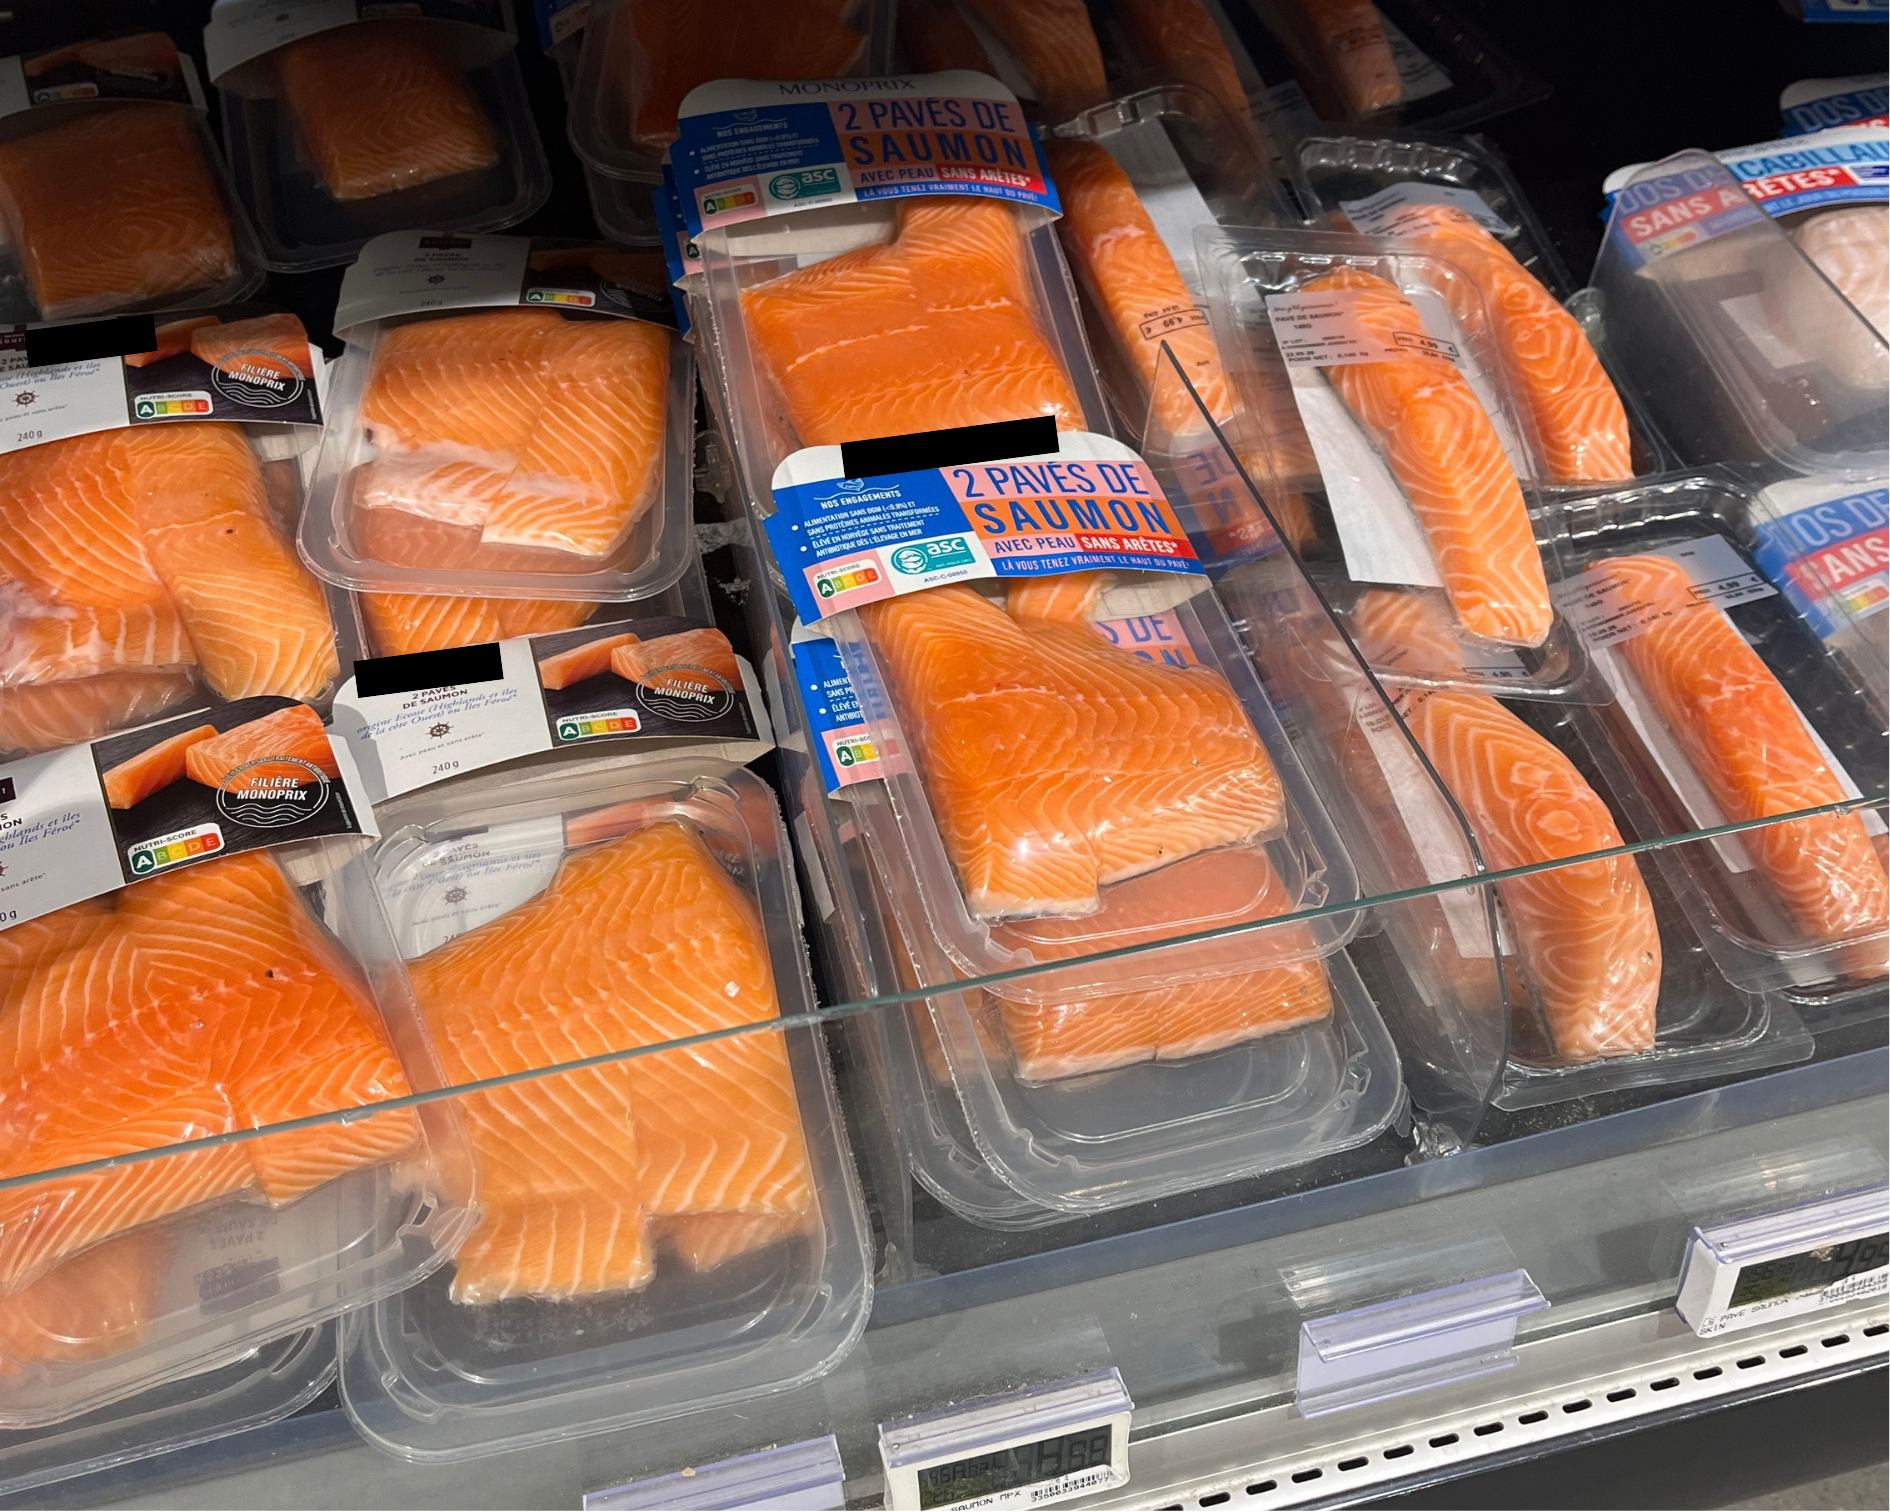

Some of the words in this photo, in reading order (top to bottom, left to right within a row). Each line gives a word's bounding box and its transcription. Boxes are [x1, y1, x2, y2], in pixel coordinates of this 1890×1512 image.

[778, 78, 917, 97] MONOPRIX
[838, 103, 862, 131] 2
[868, 97, 967, 129] PAVÉS
[972, 101, 1016, 133] DE
[850, 133, 1028, 170] SAUMON
[801, 169, 836, 184] asc
[860, 168, 895, 184] AVEC
[900, 167, 935, 182] PEAU
[940, 166, 977, 180] SANS
[877, 186, 900, 196] VOUS
[901, 184, 926, 193] TENEZ
[929, 183, 970, 192] VRAIMENT
[971, 184, 981, 193] LE
[1630, 195, 1714, 237] SANS
[2, 357, 10, 365] 2
[240, 362, 280, 380] FILIÈRE
[228, 370, 286, 392] MONOPRIX
[17, 429, 35, 443] 240
[36, 429, 43, 439] g
[953, 468, 985, 498] 2
[984, 461, 1097, 496] PAVÉS
[1097, 463, 1149, 495] DE
[820, 499, 840, 510] NOS
[840, 490, 902, 506] ENGAGEMENTS
[804, 512, 849, 528] ALIMENTATION
[849, 507, 867, 518] SANS
[807, 526, 825, 537] SANS
[860, 513, 892, 525] ANIMALES
[892, 505, 940, 519] TRANSFORMÉES
[974, 498, 1172, 535] SAUMON
[870, 524, 888, 535] SANS
[887, 519, 925, 531] TRAITEMENT
[926, 538, 966, 556] asc
[995, 537, 1033, 554] AVEC
[1037, 535, 1075, 550] PEAU
[1081, 536, 1121, 550] SANS
[816, 563, 861, 580] NUTRI-SCORE
[1003, 559, 1014, 571] LÀ
[1016, 559, 1039, 571] VOUS
[1041, 557, 1070, 569] TENEZ
[1072, 554, 1116, 565] VRAIMENT
[1118, 555, 1129, 564] LE
[1130, 556, 1152, 566] HAUT
[1153, 558, 1165, 567] DU
[666, 677, 709, 694] FILIÈRE
[826, 689, 845, 699] SANS
[402, 700, 419, 710] DE
[420, 688, 468, 705] SAUMON
[654, 686, 716, 705] MONOPRIX
[357, 718, 393, 734] origine
[429, 694, 486, 714] (Highlands
[488, 691, 499, 699] et
[562, 711, 618, 723] NUTRI-SCORE
[360, 730, 371, 740] de
[375, 726, 385, 735] la
[388, 720, 408, 732] côte
[411, 710, 444, 724] Ouest)
[447, 707, 460, 715] ou
[400, 752, 416, 761] Avec
[418, 745, 436, 755] peau
[446, 738, 463, 747] sans
[432, 761, 451, 775] 240
[452, 759, 460, 770] g
[250, 775, 300, 789] FILIÈRE
[237, 789, 308, 801] MONOPRIX
[48, 818, 58, 827] et
[0, 842, 15, 852] ou
[133, 829, 197, 853] NUTRI-SCORE
[1, 882, 20, 892] sans
[1720, 1309, 1746, 1323] PAVE
[1751, 1299, 1789, 1313] SAUMON
[1700, 1322, 1726, 1335] SKIN
[951, 1496, 994, 1511] SAUMON
[1000, 1490, 1022, 1502] MPX
